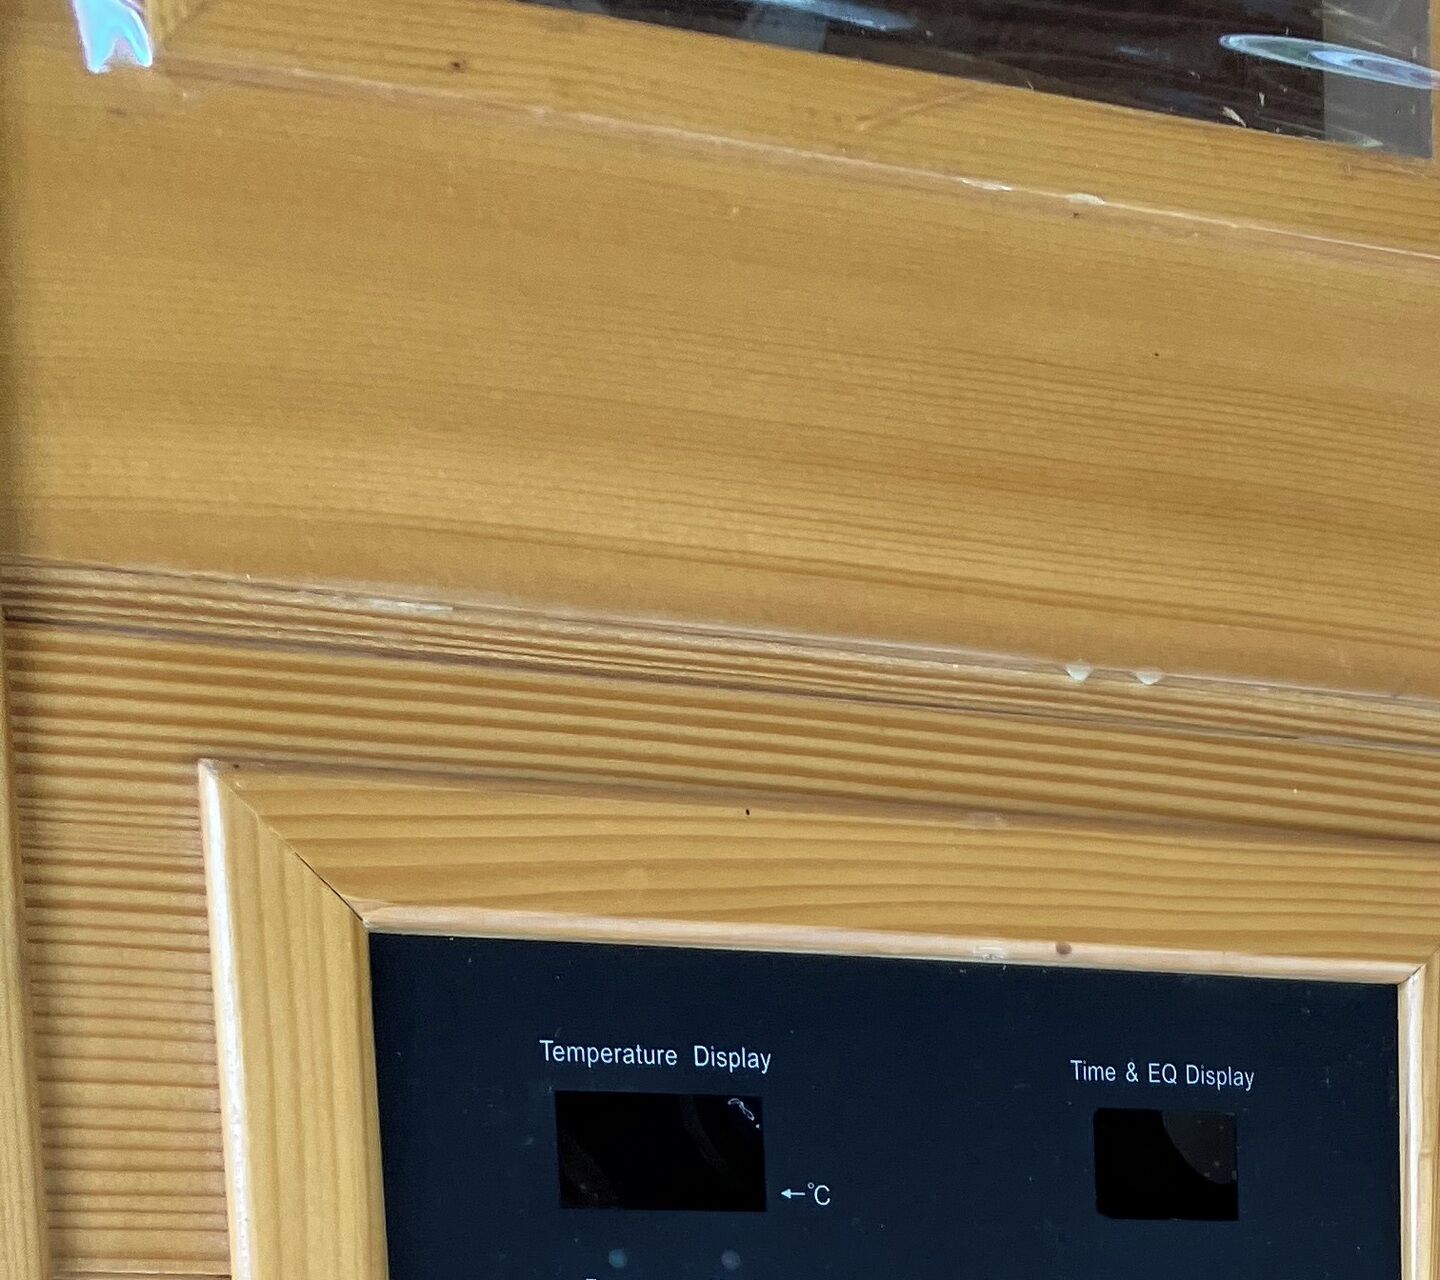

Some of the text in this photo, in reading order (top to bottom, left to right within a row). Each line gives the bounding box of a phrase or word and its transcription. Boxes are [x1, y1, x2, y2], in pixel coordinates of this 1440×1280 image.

[538, 1039, 771, 1075] Temperature Display
[1070, 1059, 1255, 1092] Time & EQ Display
